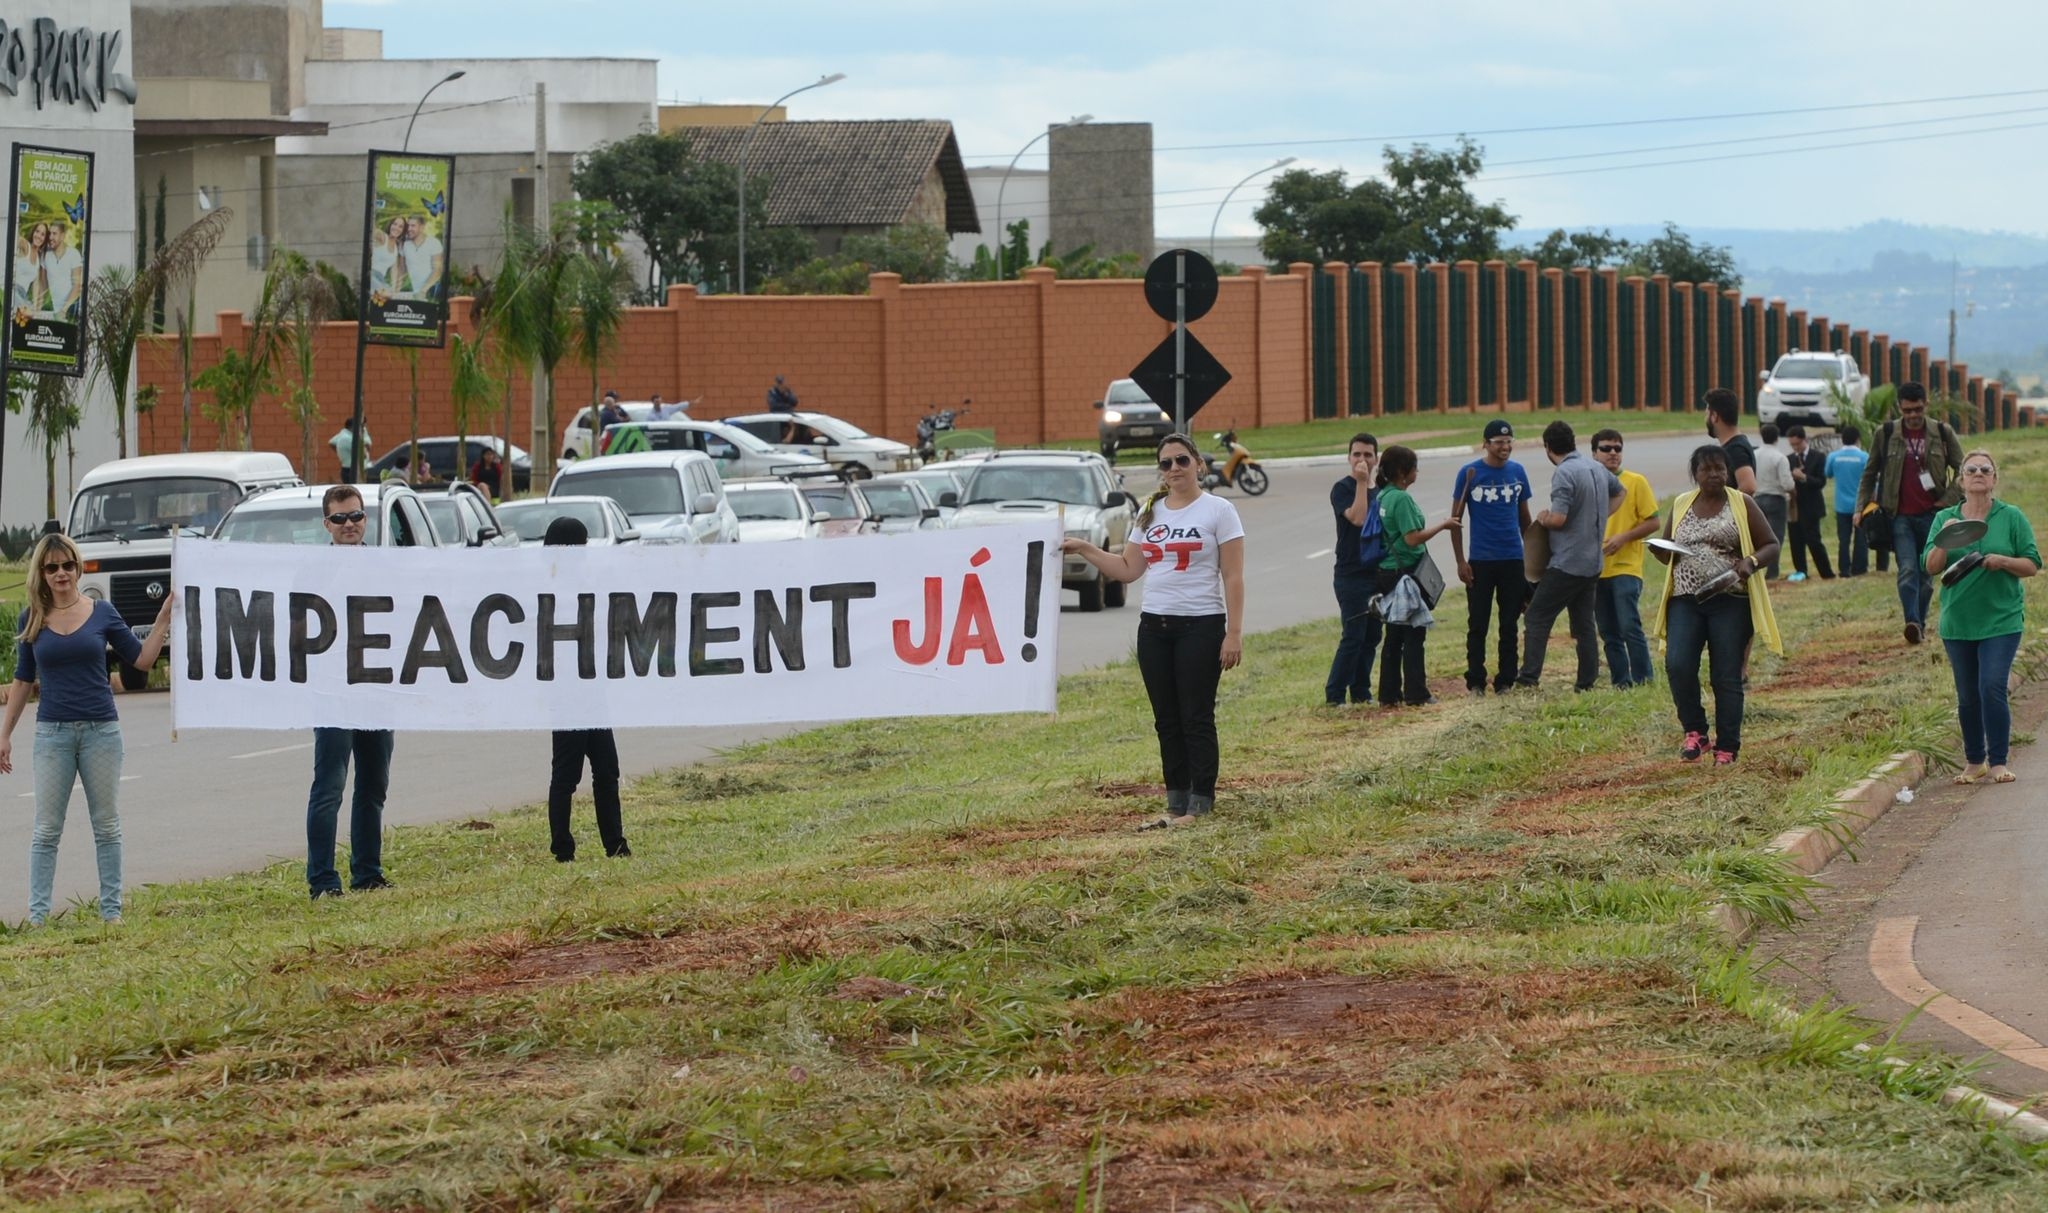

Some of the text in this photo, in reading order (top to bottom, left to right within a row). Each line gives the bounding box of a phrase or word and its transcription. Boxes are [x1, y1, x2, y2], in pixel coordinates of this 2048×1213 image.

[31, 17, 137, 112] PARK
[34, 158, 51, 170] BEM
[391, 163, 409, 171] BEM
[29, 169, 79, 184] UM PARQUE
[385, 171, 436, 183] UM PARQUE
[1145, 523, 1202, 544] ORA
[184, 581, 877, 687] IMPEACHMENT
